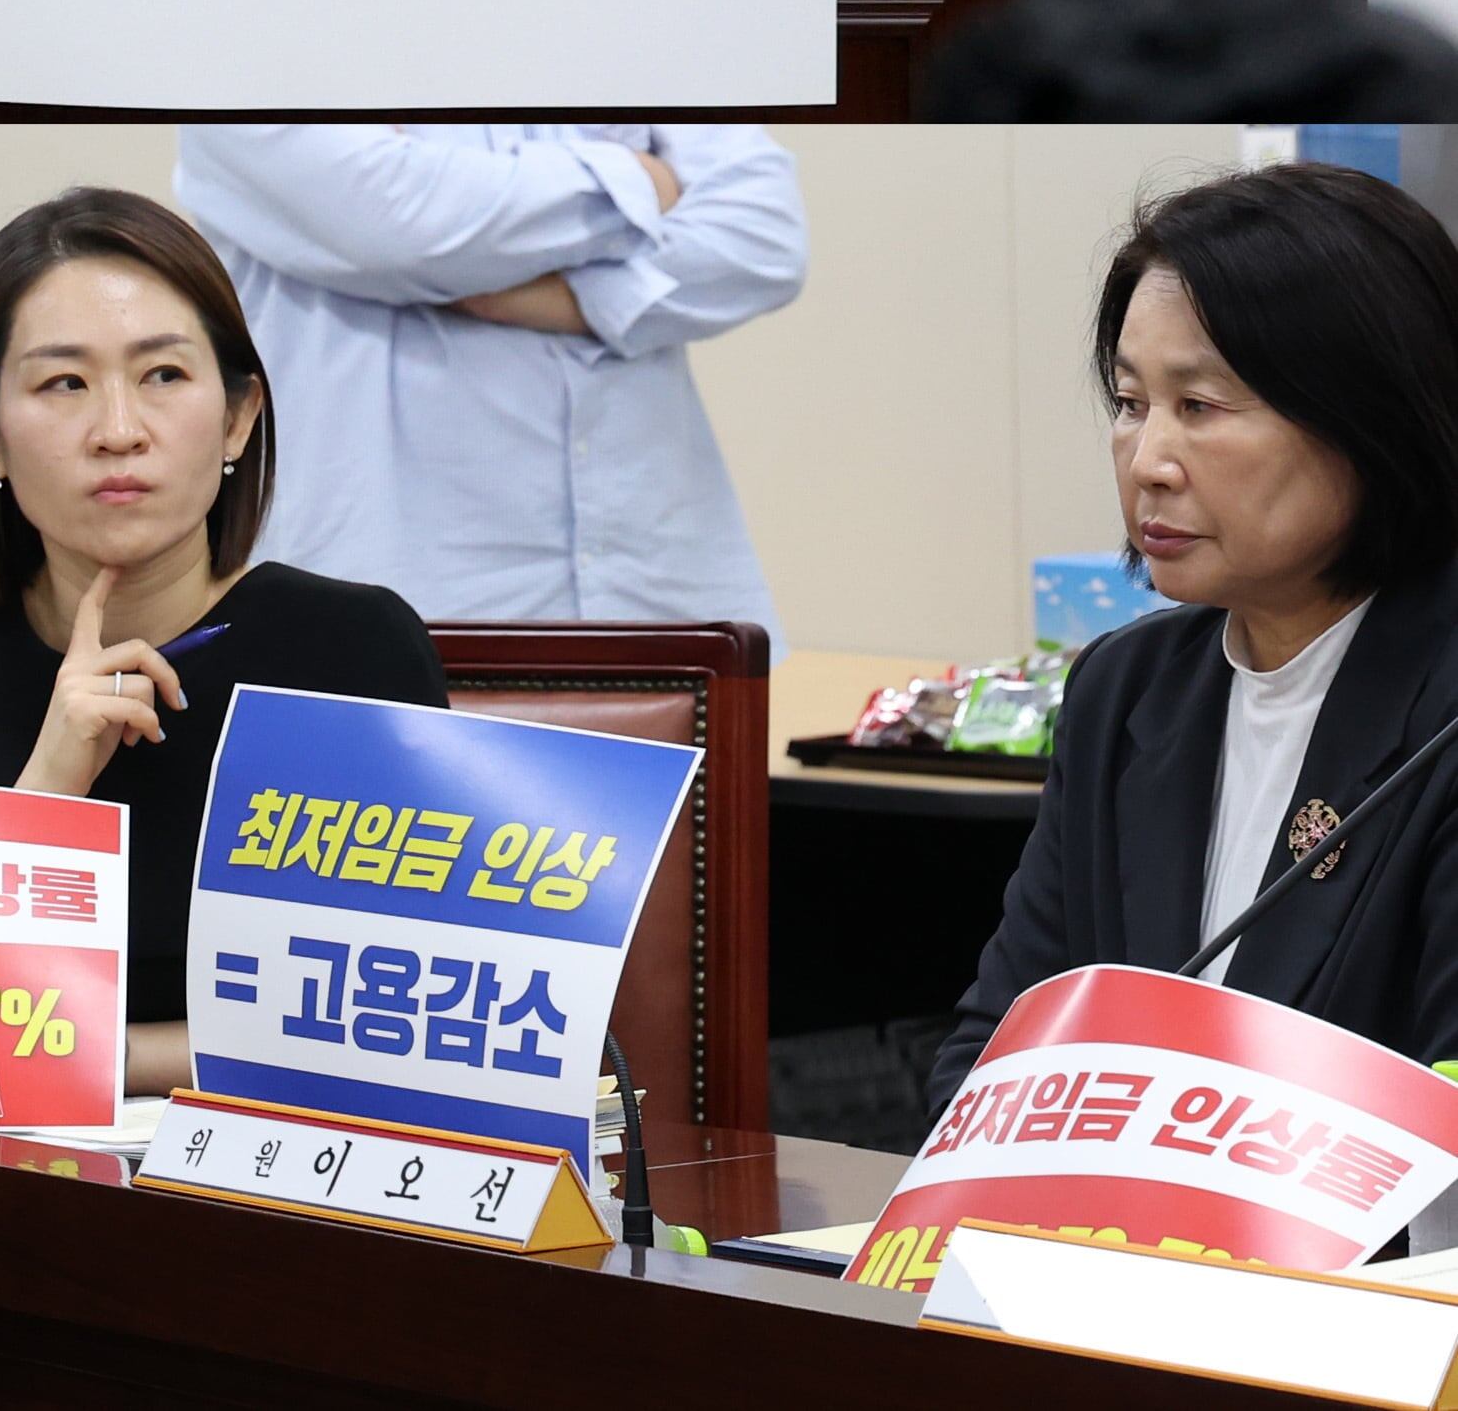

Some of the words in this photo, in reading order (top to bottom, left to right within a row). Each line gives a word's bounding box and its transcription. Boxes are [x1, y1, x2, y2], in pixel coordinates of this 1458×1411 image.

[228, 787, 474, 893] 최저임금
[466, 820, 617, 912] 인상
[281, 935, 569, 1079] 고용감소
[923, 1070, 1156, 1160] 최저임금
[1150, 1085, 1414, 1213] 인상률
